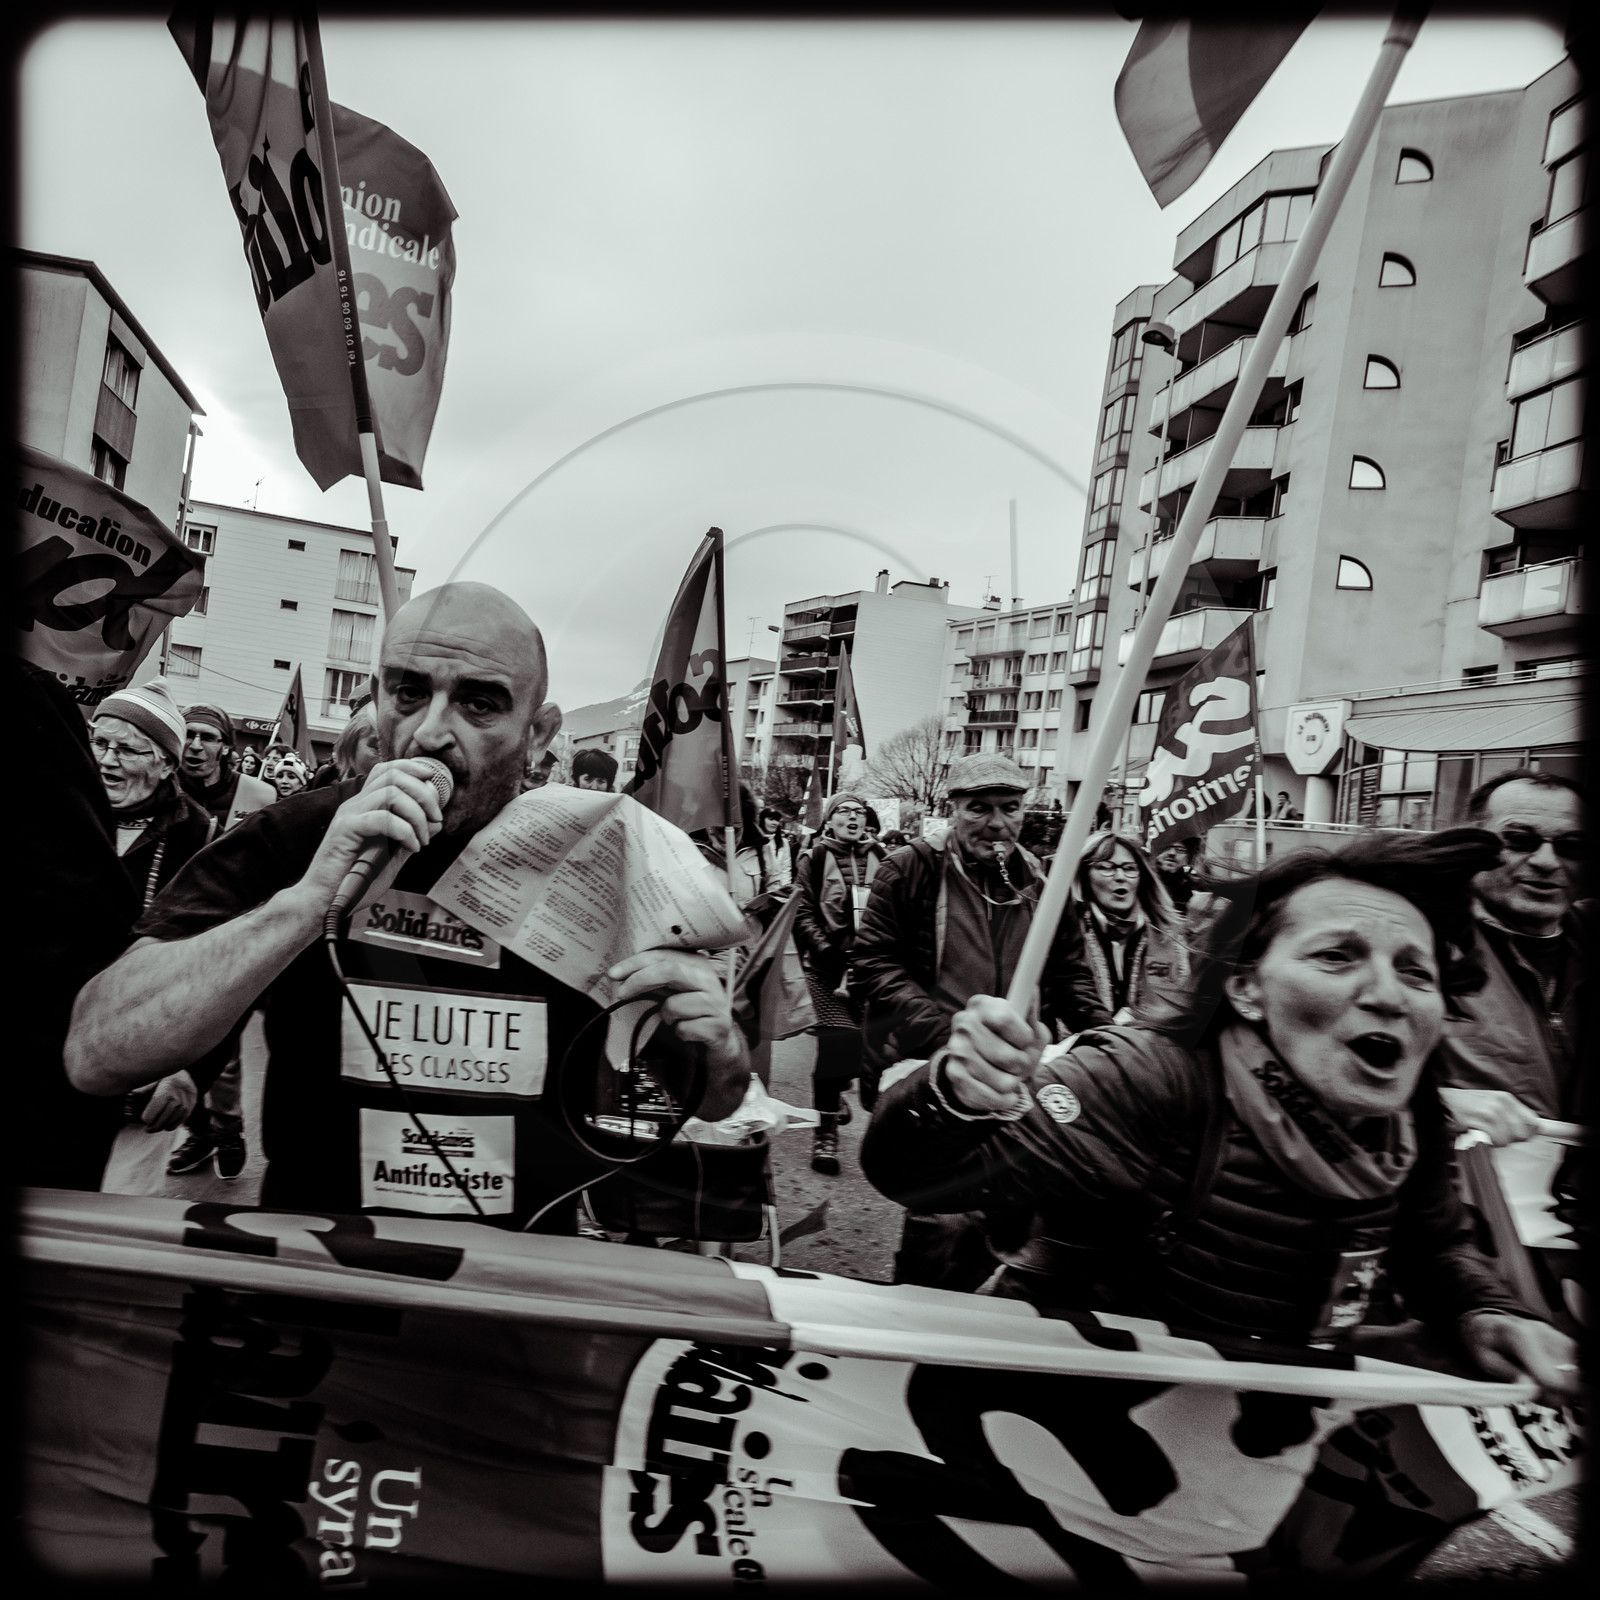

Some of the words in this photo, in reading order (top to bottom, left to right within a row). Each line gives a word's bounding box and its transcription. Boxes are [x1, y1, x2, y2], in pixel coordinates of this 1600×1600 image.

[337, 269, 347, 283] 16
[339, 285, 350, 299] 16
[343, 317, 353, 330] 60
[345, 334, 355, 346] 01
[367, 902, 485, 950] Solidaires
[371, 1000, 403, 1041] JE
[413, 1004, 522, 1052] LUTTE
[420, 1055, 511, 1084] CLASSES
